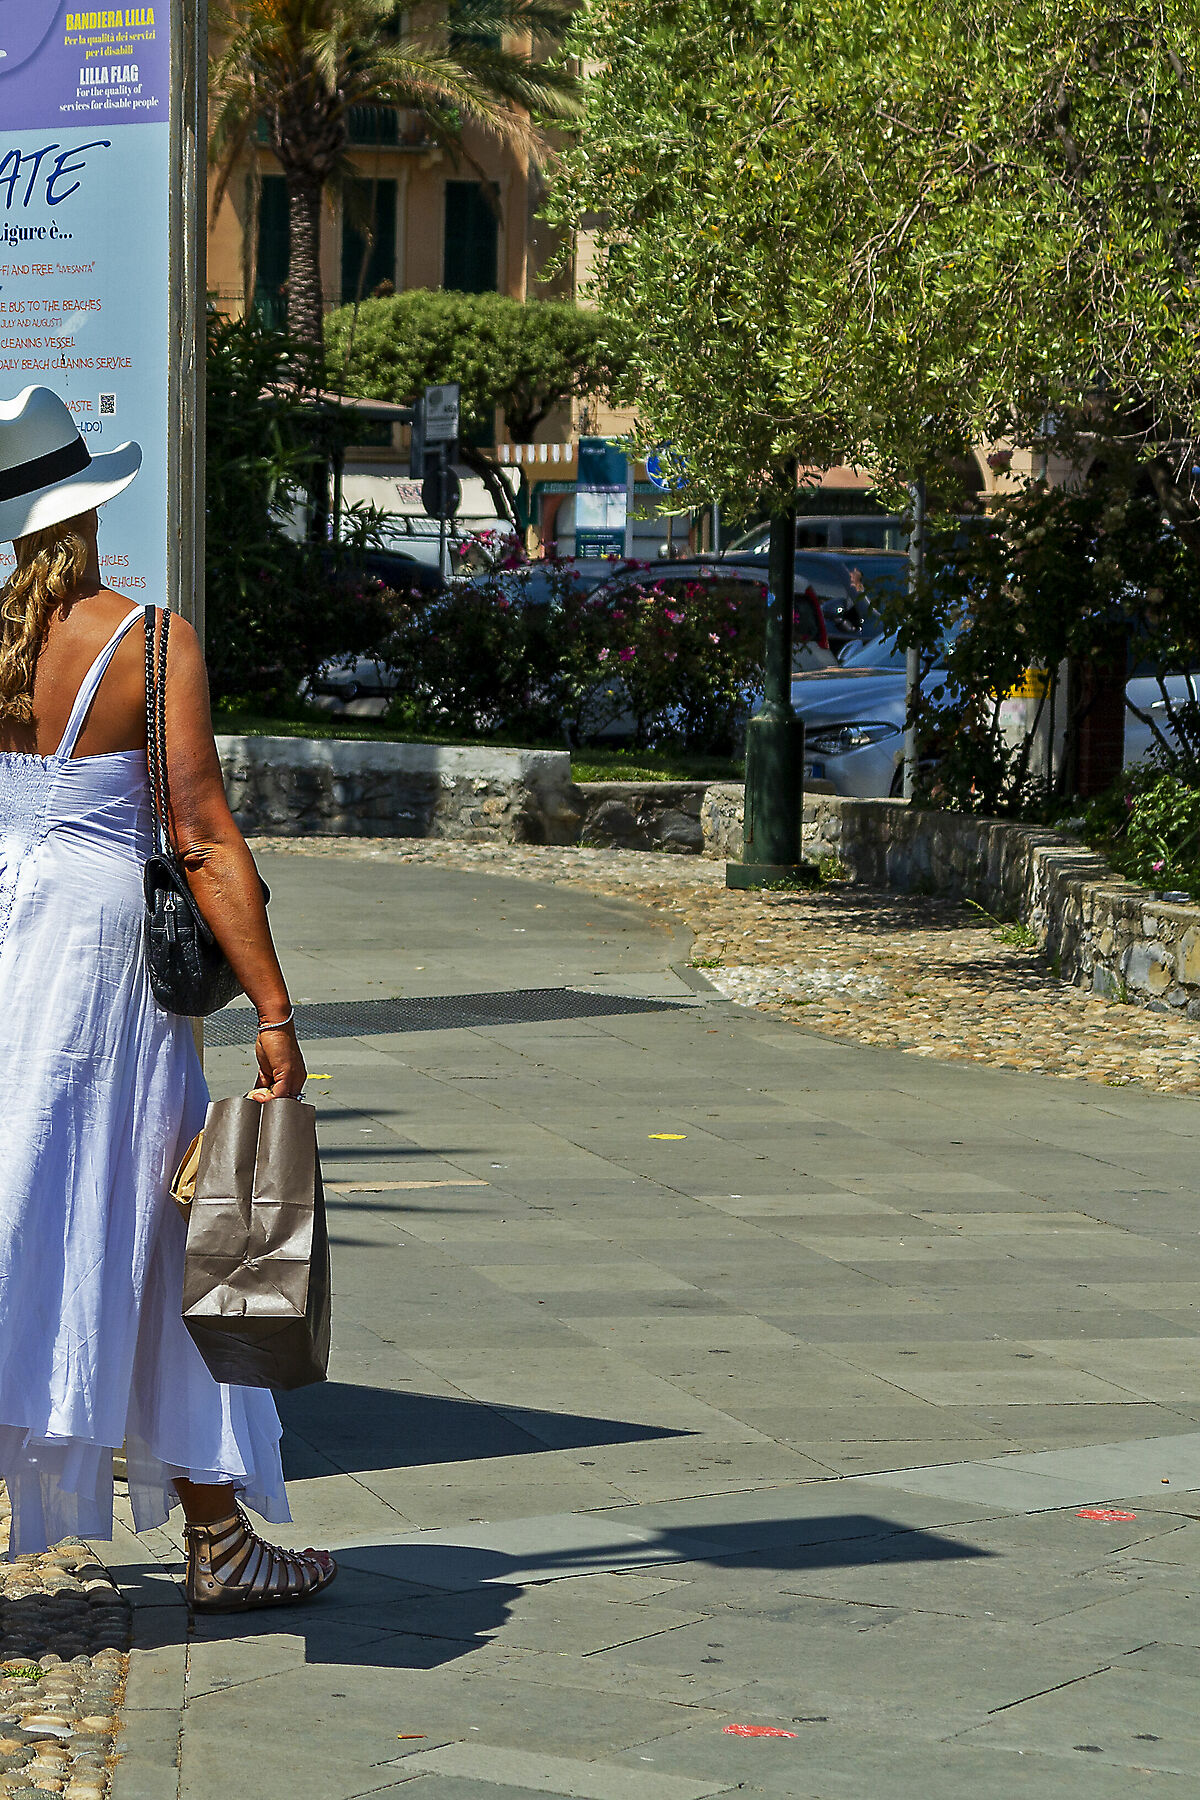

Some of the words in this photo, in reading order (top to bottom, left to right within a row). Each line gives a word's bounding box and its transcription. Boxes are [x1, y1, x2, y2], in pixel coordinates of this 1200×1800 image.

[66, 10, 123, 30] BANDIERA
[125, 8, 154, 26] LILLA
[65, 37, 78, 45] Per
[79, 35, 86, 44] la
[88, 33, 114, 46] qualità
[116, 32, 128, 41] dei
[129, 30, 155, 40] servizi
[86, 50, 99, 60] per
[105, 45, 133, 55] disabili
[80, 67, 108, 85] LILLA
[111, 64, 138, 83] FLAG
[77, 88, 90, 97] For
[91, 86, 103, 95] the
[105, 85, 131, 97] quality
[133, 84, 142, 93] of
[60, 101, 90, 111] services
[91, 100, 102, 109] for
[104, 98, 131, 109] disable
[133, 97, 159, 109] people
[11, 265, 29, 275] AND
[32, 264, 53, 276] FREE
[9, 302, 25, 313] BUS
[27, 300, 40, 311] TO
[42, 300, 60, 312] THE
[62, 299, 101, 311] BEACHES
[1, 338, 42, 349] CLEANING
[44, 337, 76, 349] VESSEL
[106, 576, 146, 589] VEHICLES
